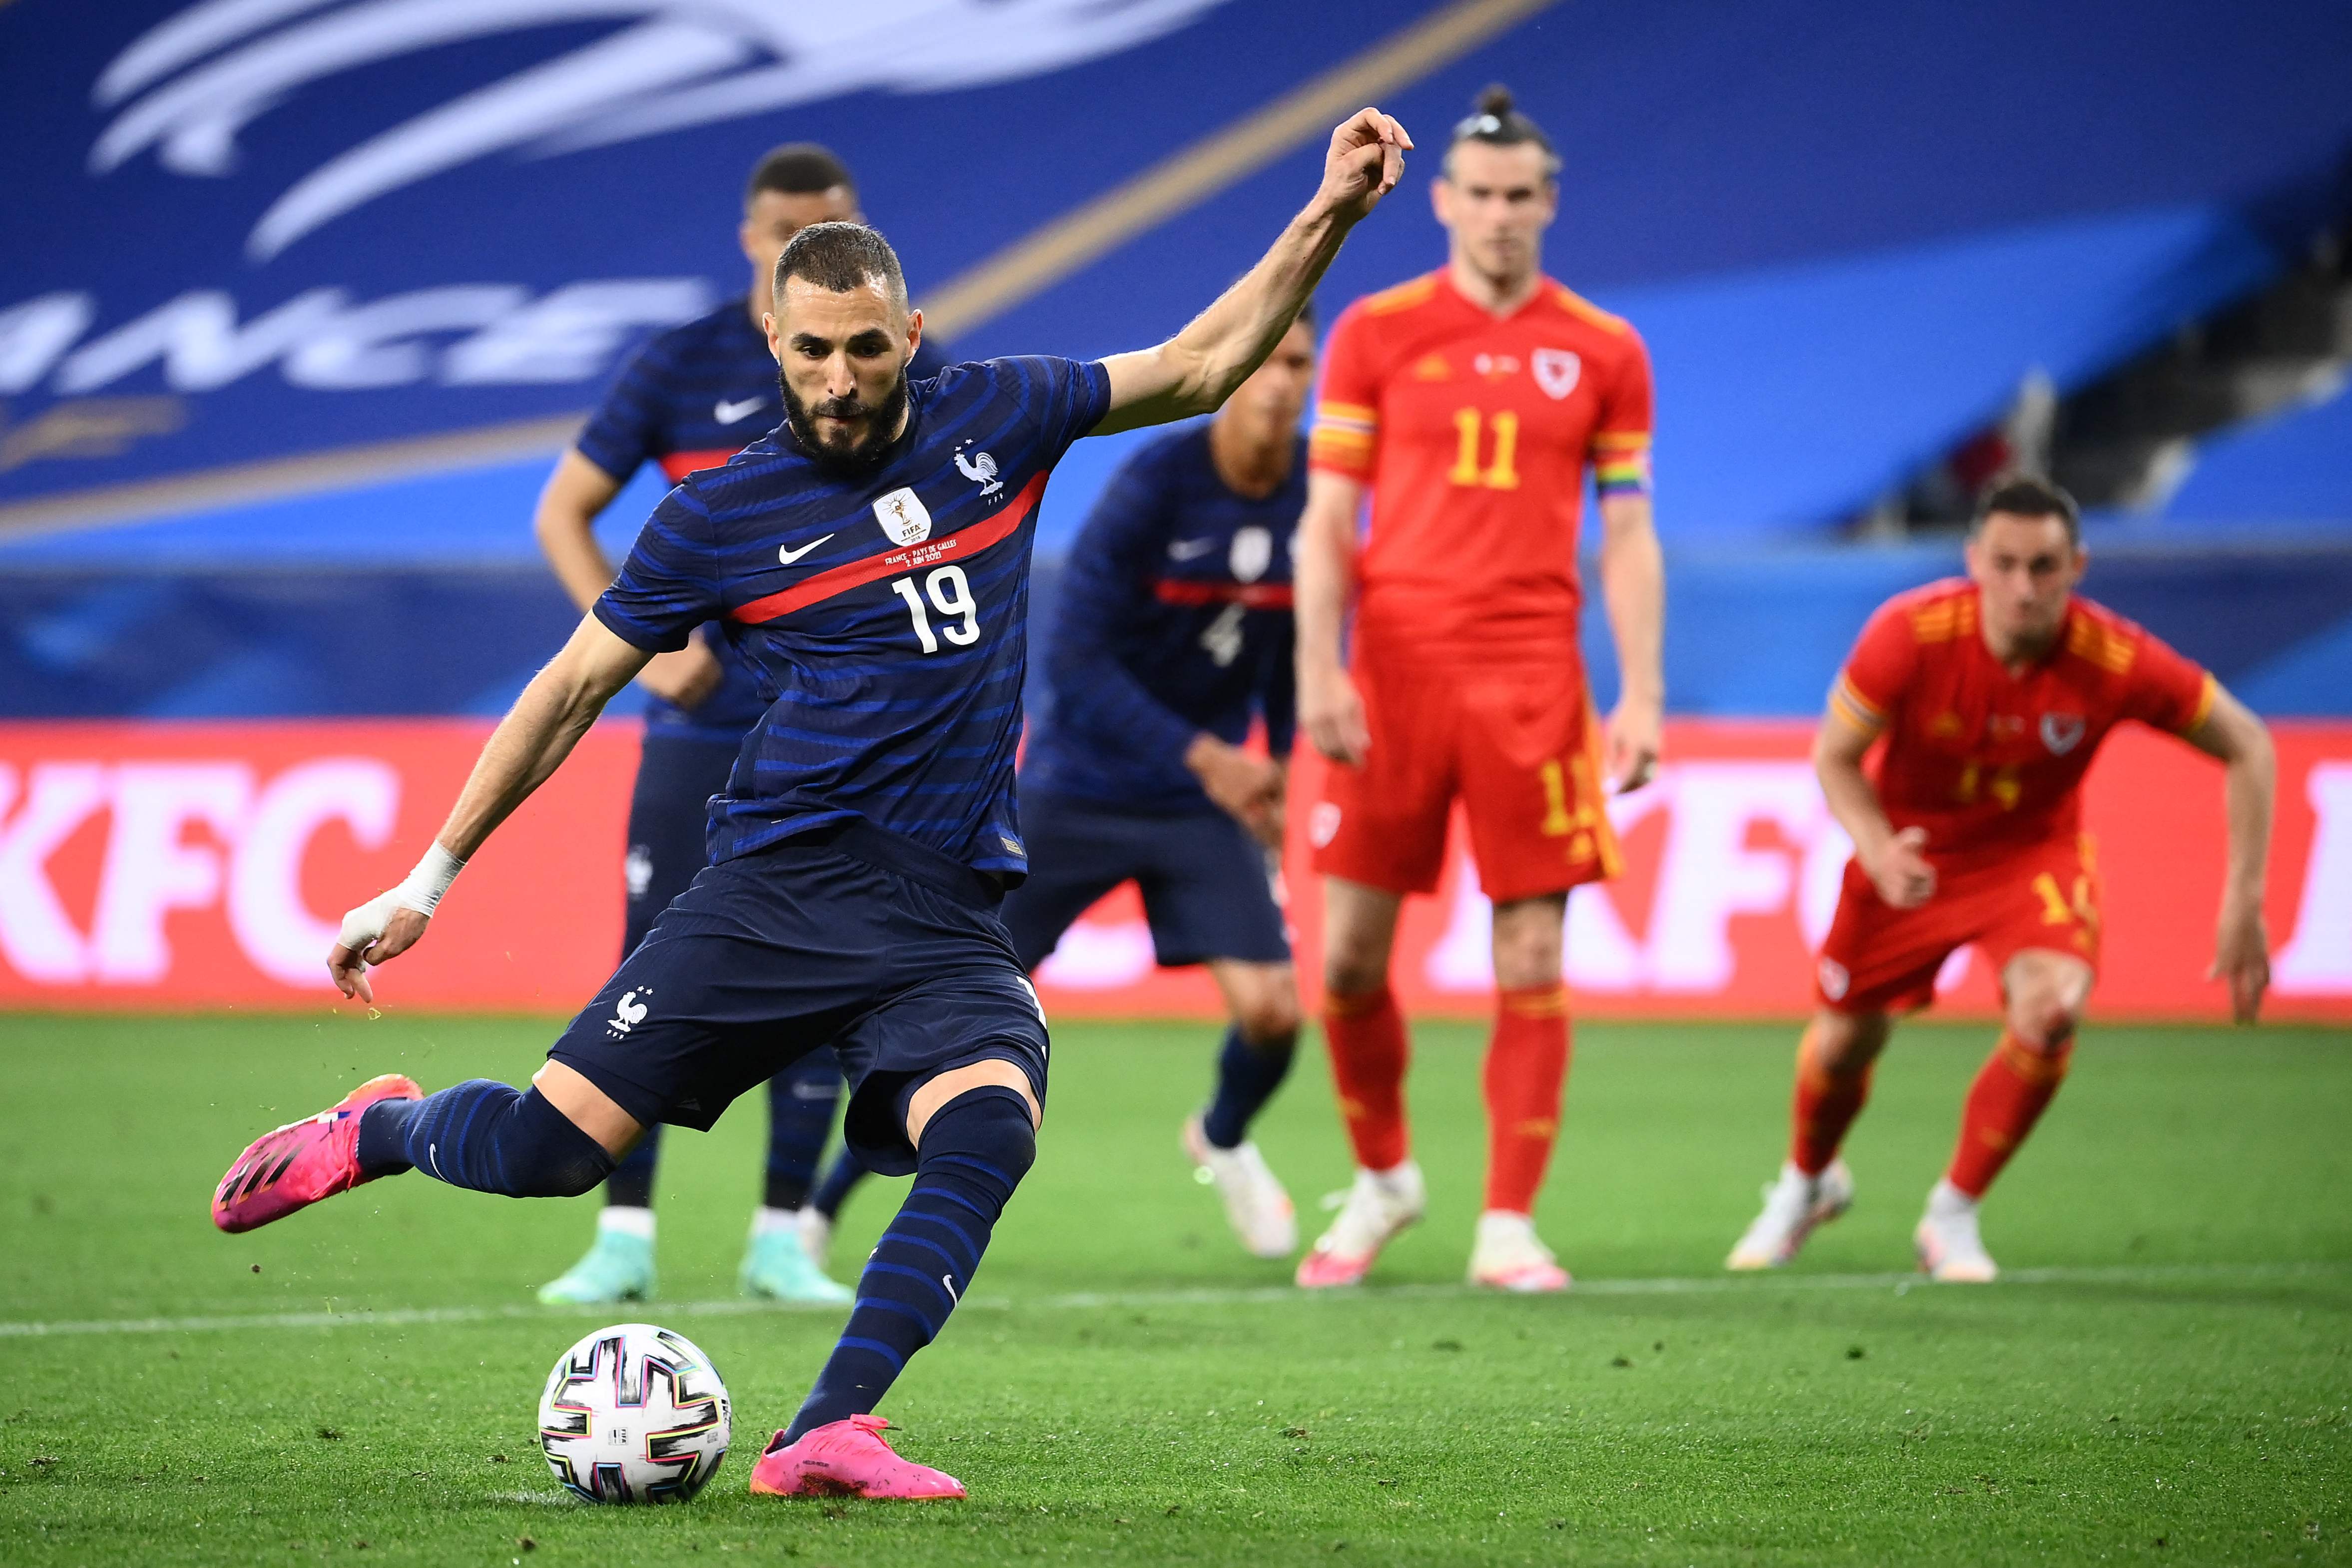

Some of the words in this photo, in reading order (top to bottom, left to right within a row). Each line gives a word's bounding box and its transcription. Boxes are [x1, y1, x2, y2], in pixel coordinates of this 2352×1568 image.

[1449, 406, 1519, 491] 11
[885, 553, 907, 565] FRANCE
[912, 546, 928, 557] PAYS
[929, 544, 937, 554] DE
[937, 539, 957, 551] GALLES
[902, 523, 921, 537] FIFA
[925, 551, 942, 562] 2021
[892, 565, 980, 654] 19
[0, 755, 402, 989] KFC
